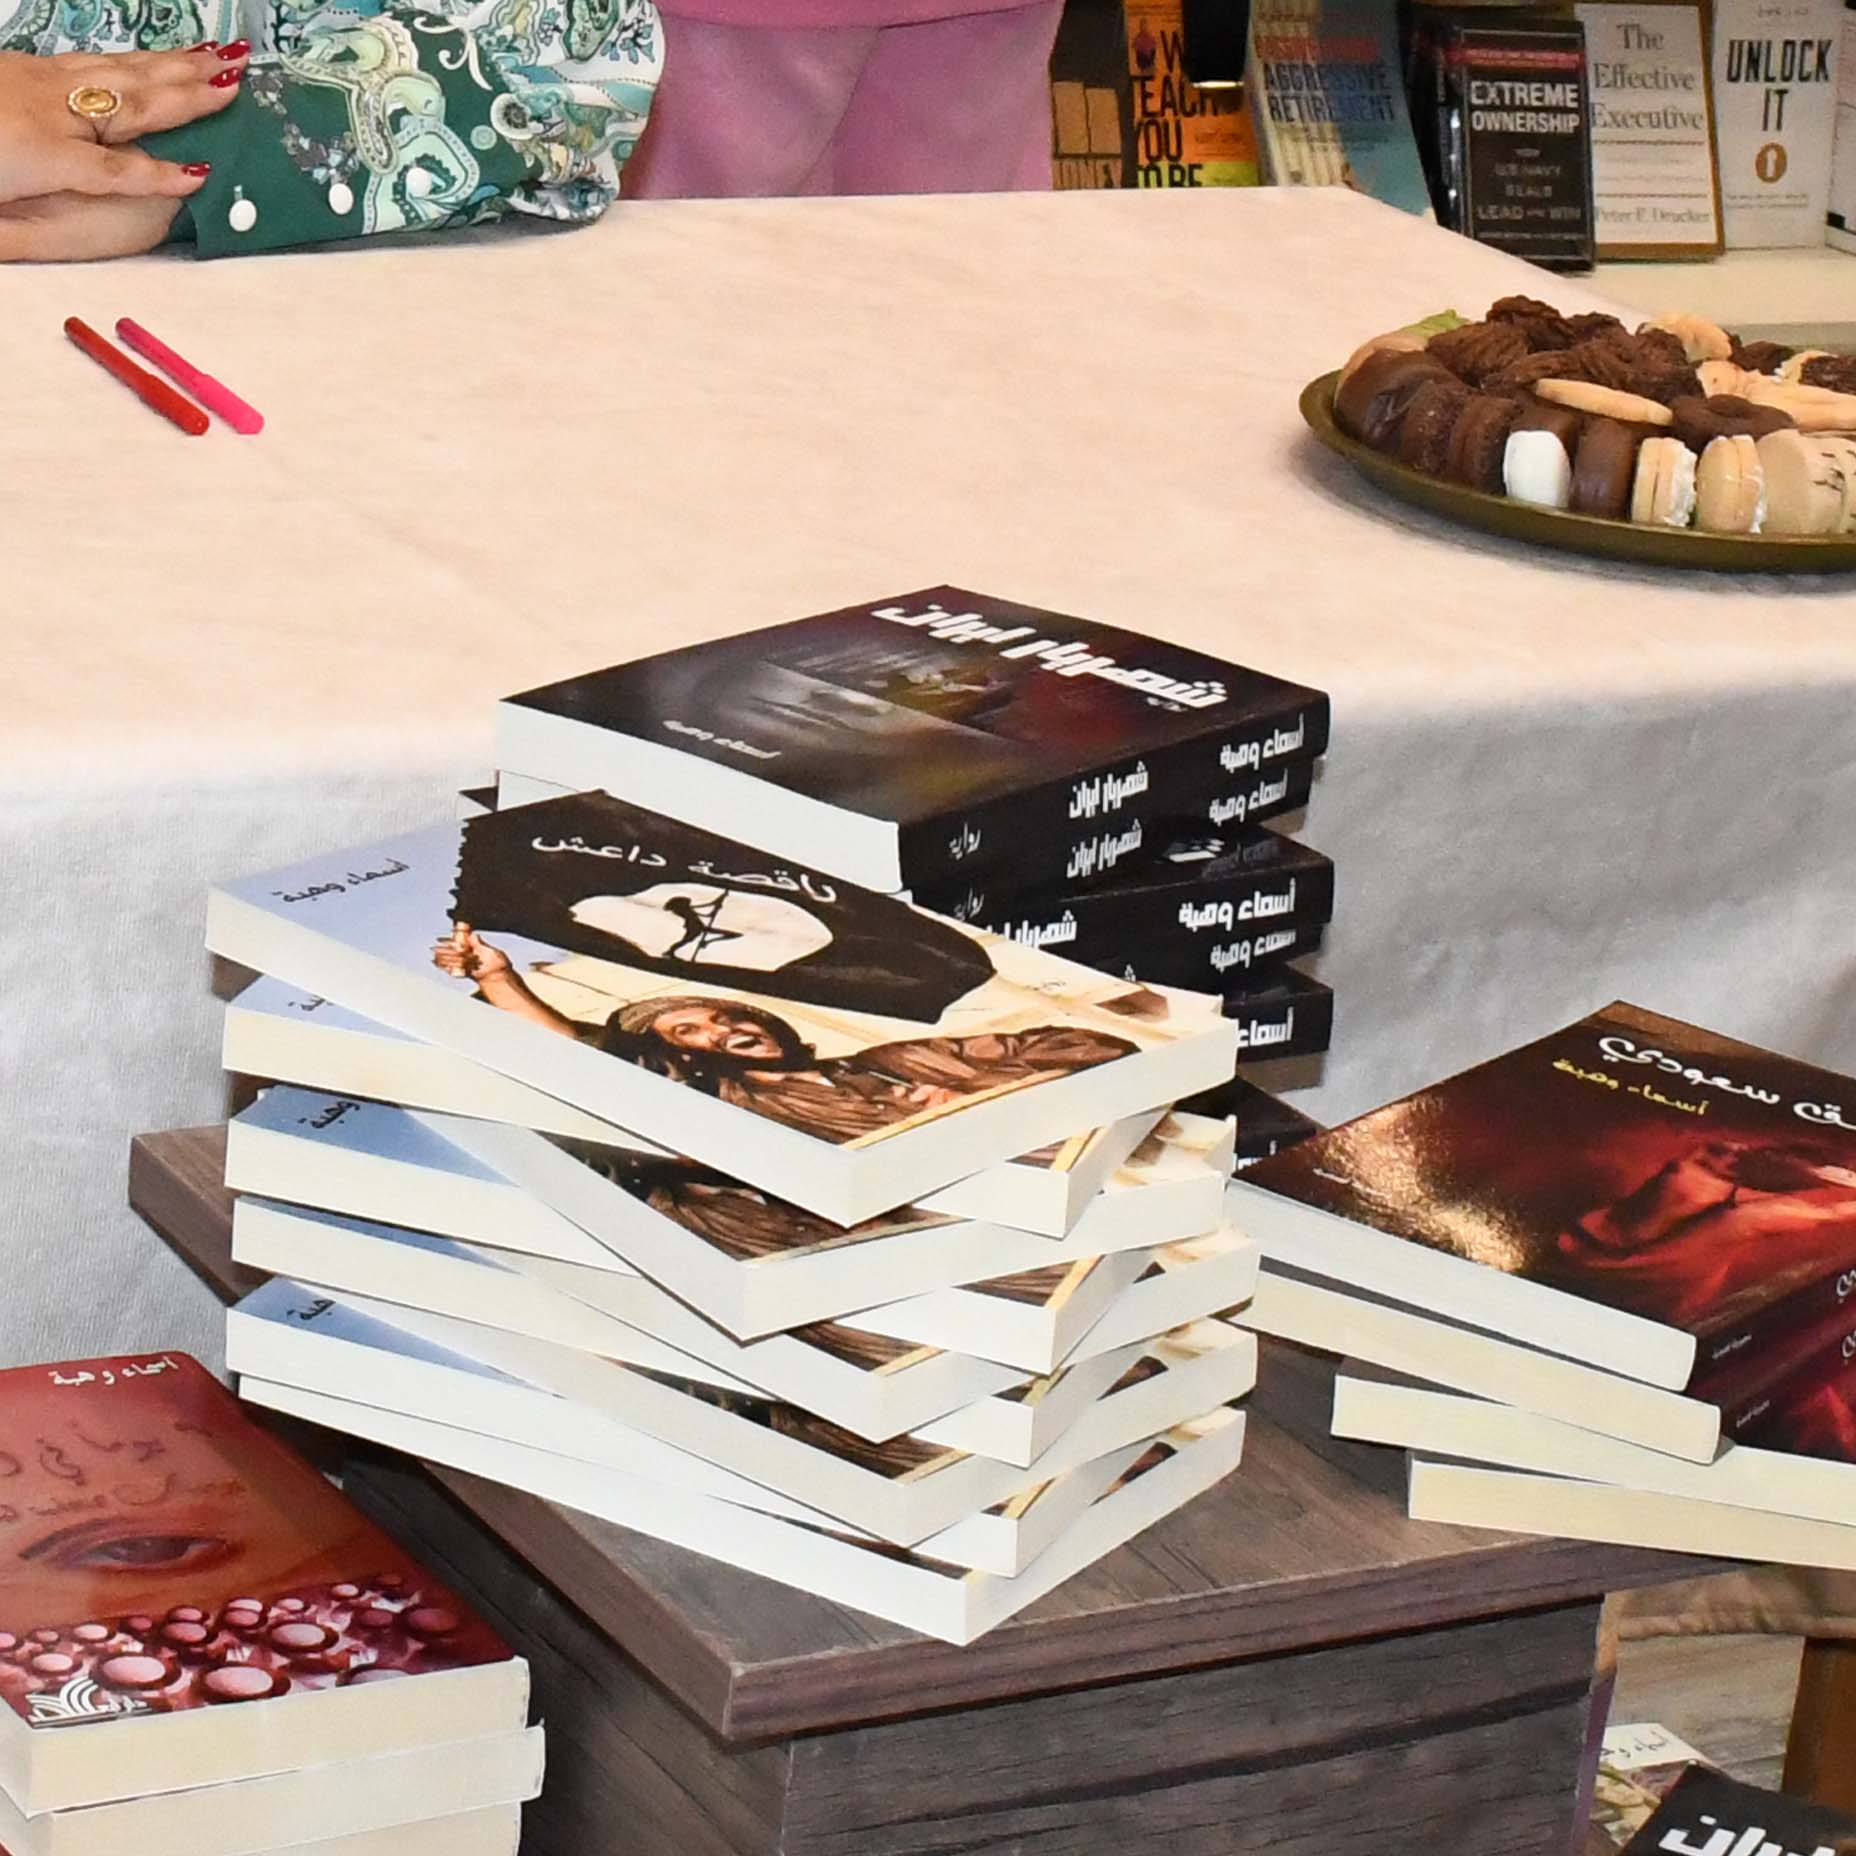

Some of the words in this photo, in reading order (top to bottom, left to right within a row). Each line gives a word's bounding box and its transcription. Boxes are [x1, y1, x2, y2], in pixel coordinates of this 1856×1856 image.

[1616, 23, 1664, 52] The
[1593, 62, 1695, 92] Effective
[1726, 39, 1834, 84] UNLOCK
[1470, 80, 1579, 110] EXTREME
[1762, 88, 1789, 132] IT
[1471, 111, 1581, 134] OWNERSHIP
[1590, 103, 1705, 131] Executive
[1262, 712, 1305, 757] أسماء
[1219, 740, 1260, 772] وهبة
[1104, 760, 1150, 811] شهريار
[531, 833, 667, 868] داعش
[346, 858, 410, 886] أسماء
[687, 859, 838, 904] راقصة
[271, 878, 345, 905] وهبة
[1237, 876, 1297, 921] أسماء
[1178, 900, 1233, 933] وهبة
[1552, 1057, 1621, 1091] وهبة
[1597, 1034, 1782, 1107] سعودي
[1626, 1083, 1710, 1118] أسماء
